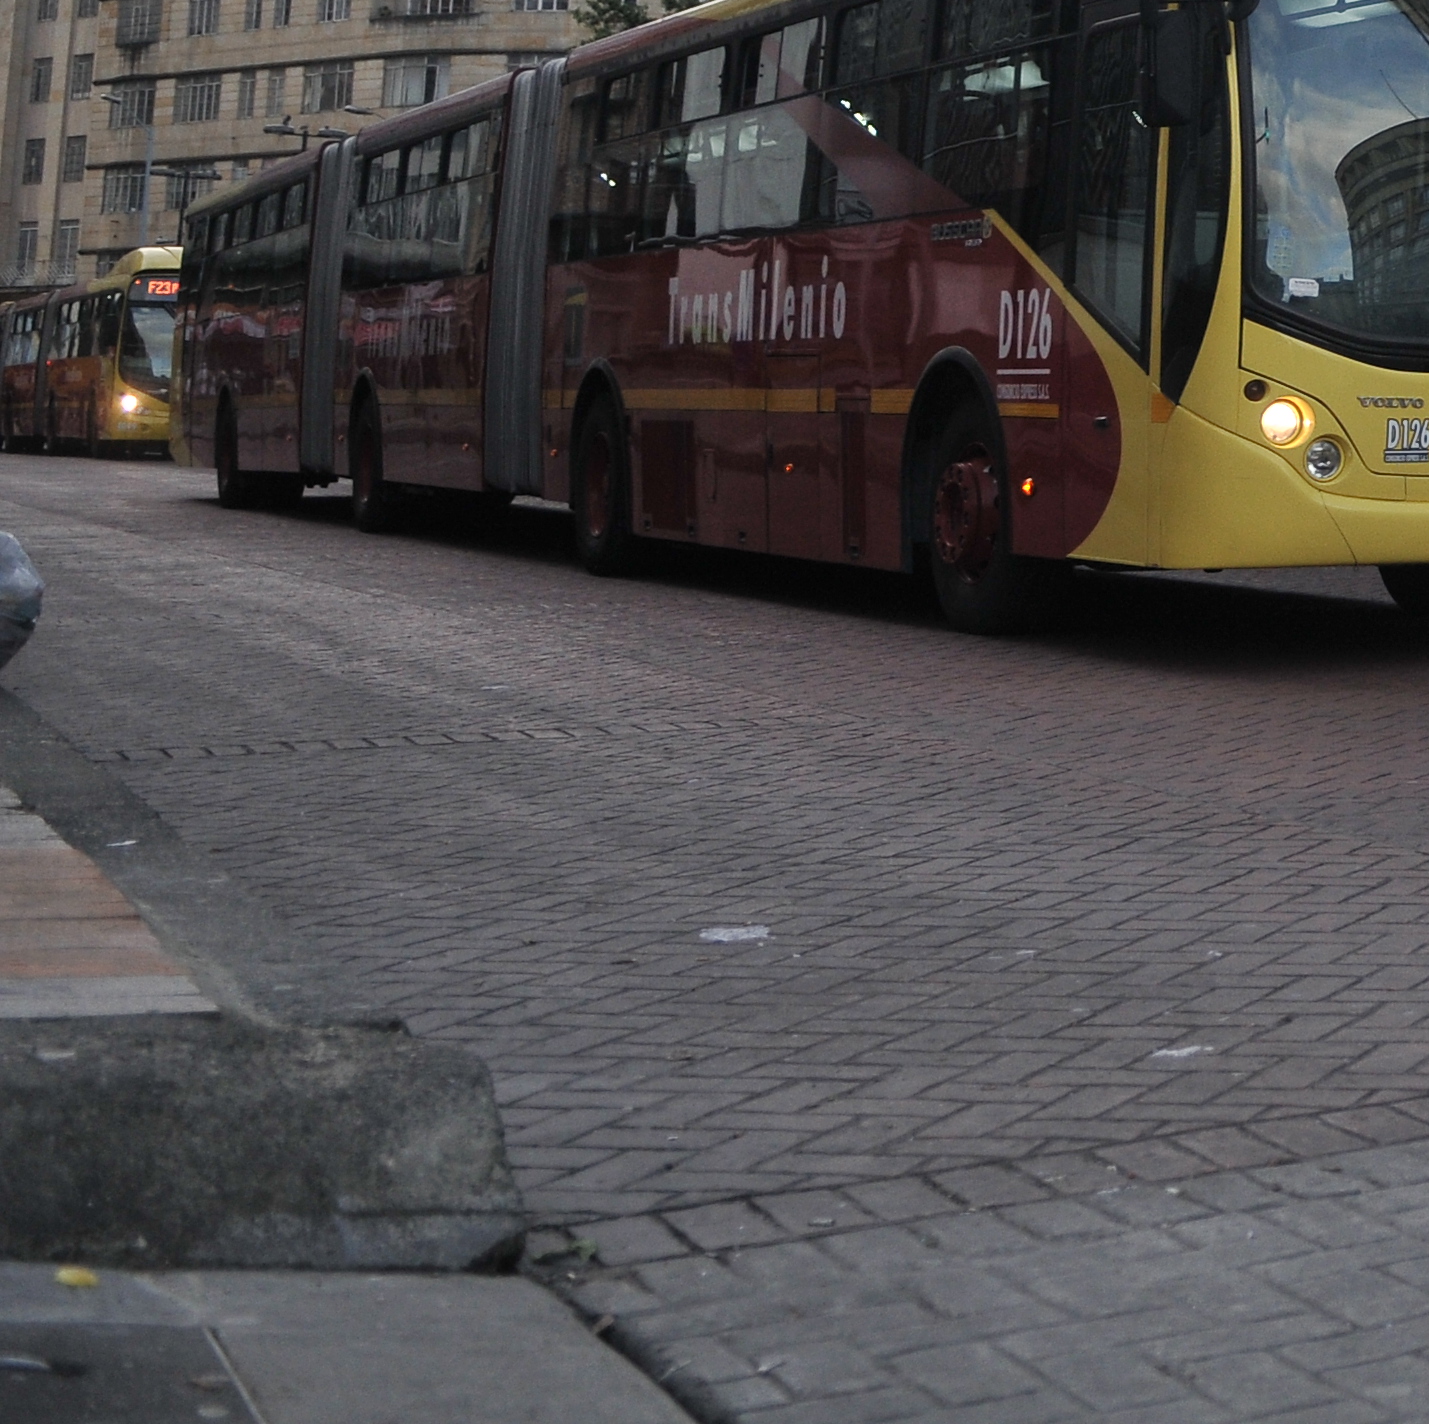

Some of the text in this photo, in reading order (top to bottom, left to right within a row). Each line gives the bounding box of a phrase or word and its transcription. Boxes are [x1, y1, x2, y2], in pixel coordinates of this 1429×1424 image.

[147, 279, 172, 296] F23
[667, 254, 847, 345] TransMilenio
[998, 287, 1053, 360] D126
[1356, 395, 1425, 410] VOLVO
